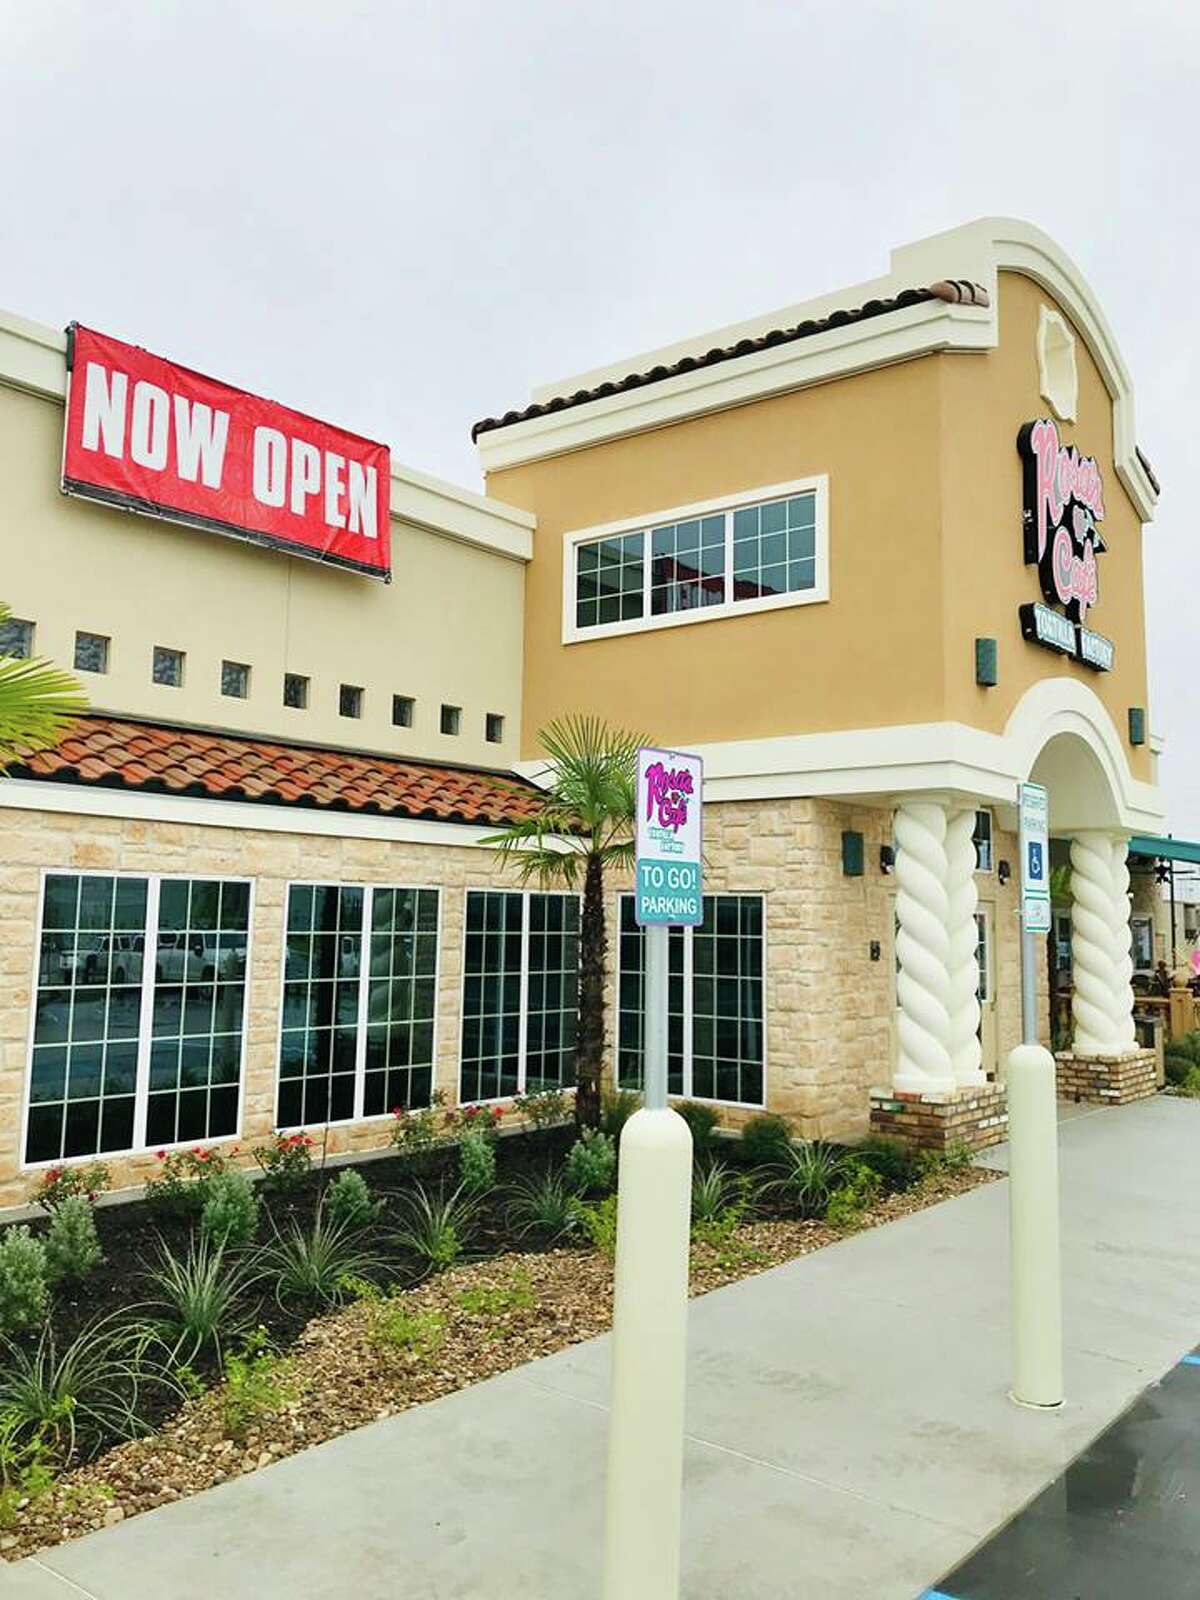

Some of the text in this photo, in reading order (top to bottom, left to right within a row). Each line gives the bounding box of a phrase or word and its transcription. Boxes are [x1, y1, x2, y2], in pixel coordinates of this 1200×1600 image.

[81, 361, 379, 539] NOW OPEN
[641, 866, 697, 890] TO GO!
[641, 896, 698, 915] PARKING
